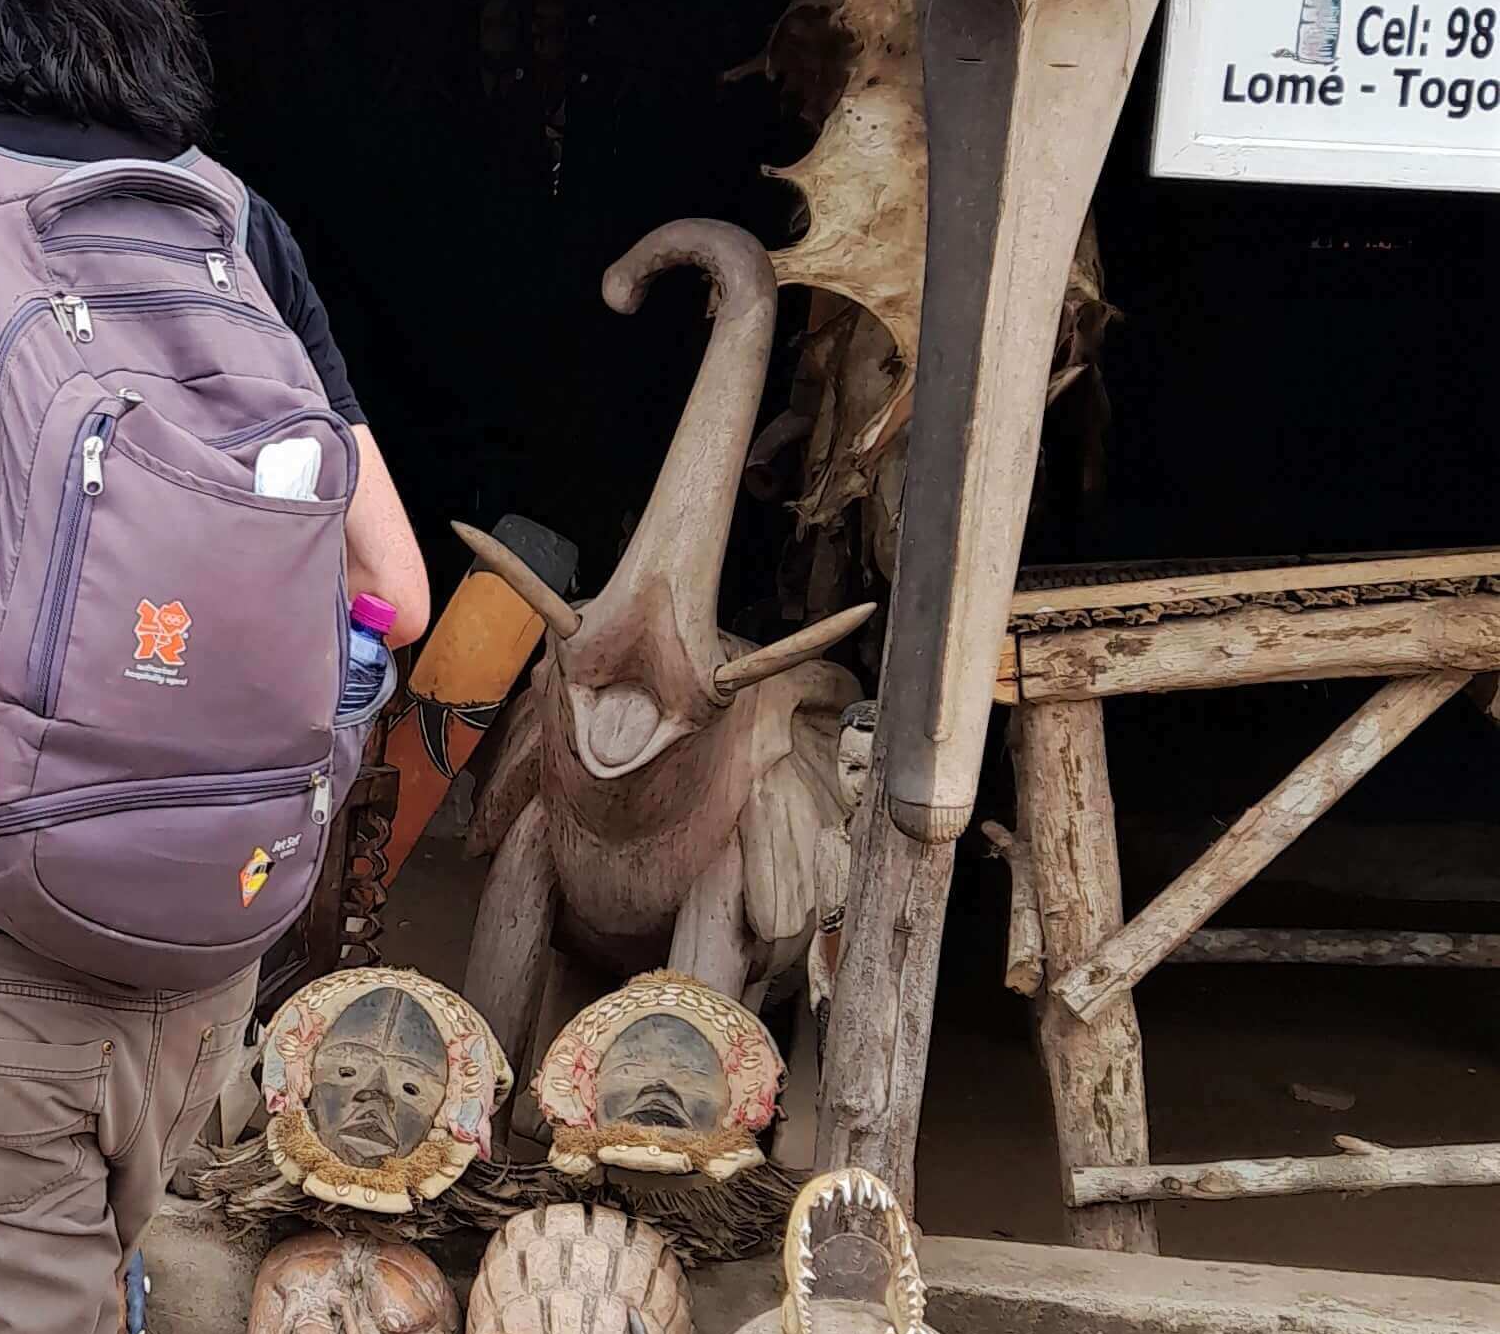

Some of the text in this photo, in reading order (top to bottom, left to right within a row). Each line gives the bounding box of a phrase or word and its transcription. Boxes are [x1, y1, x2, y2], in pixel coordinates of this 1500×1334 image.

[1356, 4, 1497, 59] Cel: 98
[1222, 63, 1345, 106] Lomé
[1393, 67, 1500, 119] Togo
